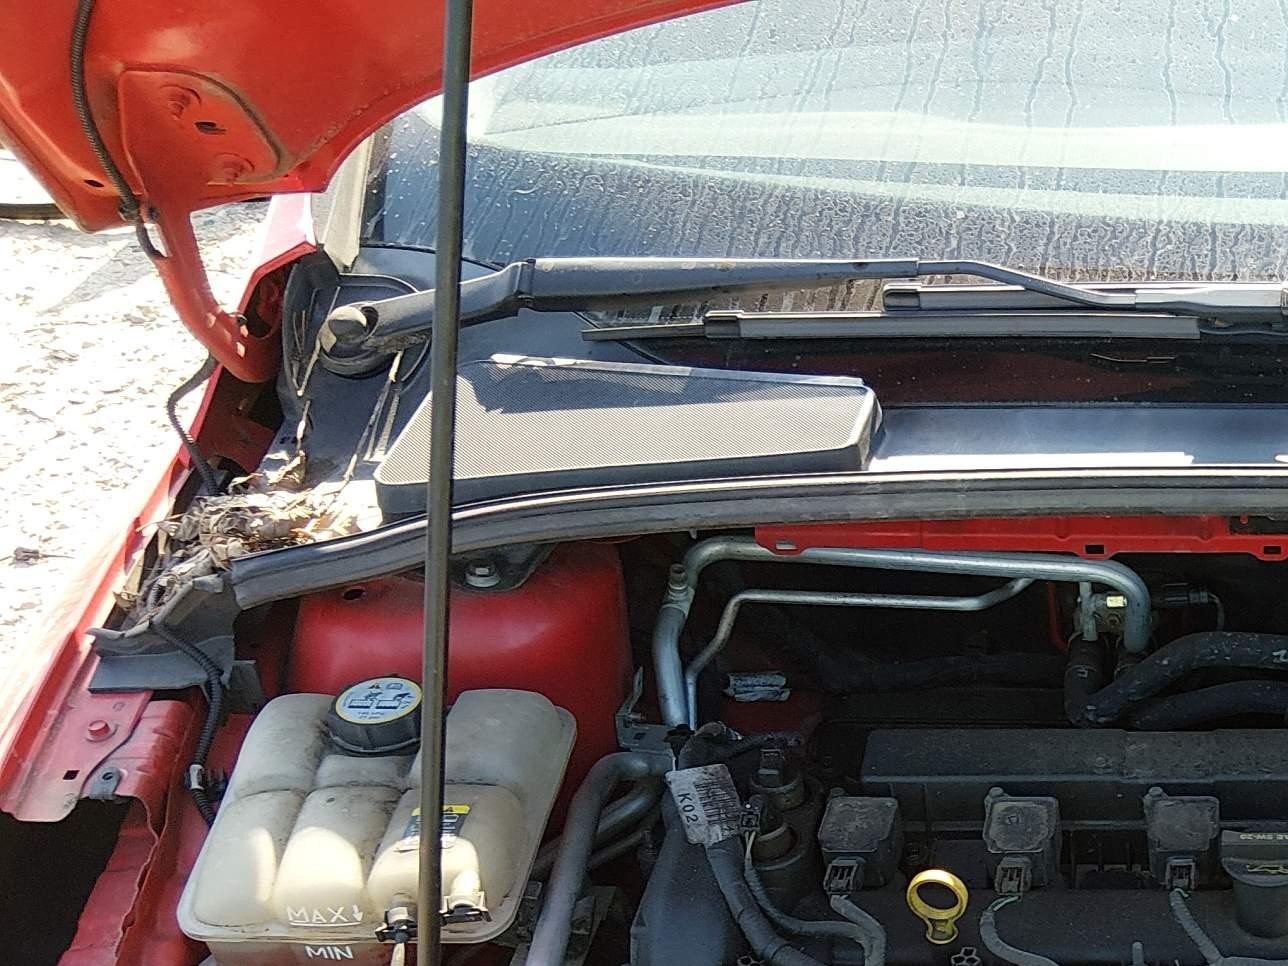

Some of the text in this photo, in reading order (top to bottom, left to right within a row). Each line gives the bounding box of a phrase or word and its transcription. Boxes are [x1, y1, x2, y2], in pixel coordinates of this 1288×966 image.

[678, 792, 699, 824] K02
[286, 904, 349, 923] MAX
[304, 945, 354, 960] MIN
